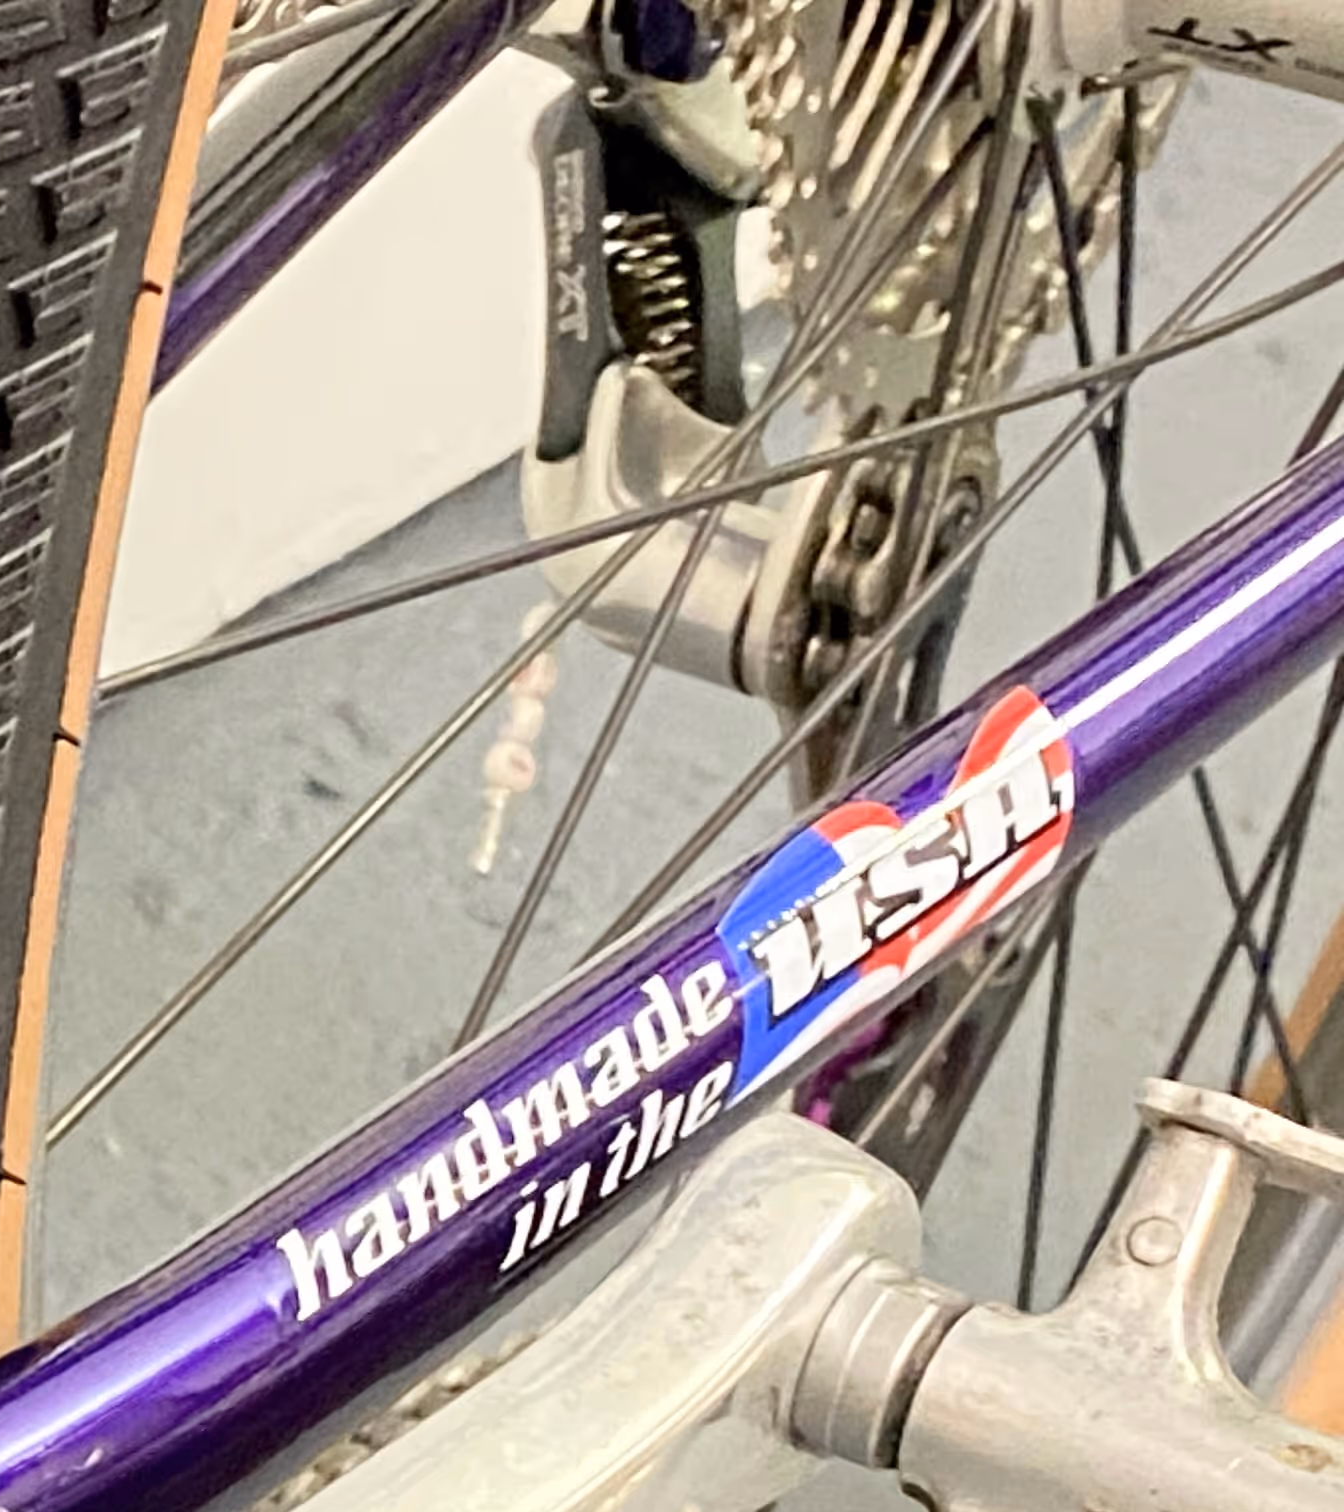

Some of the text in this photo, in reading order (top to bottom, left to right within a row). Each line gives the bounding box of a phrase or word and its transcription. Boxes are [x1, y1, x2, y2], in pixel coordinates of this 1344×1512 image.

[557, 263, 589, 342] XT
[746, 745, 1062, 1032] USA
[276, 959, 735, 1322] handmade
[499, 1060, 733, 1272] in the
